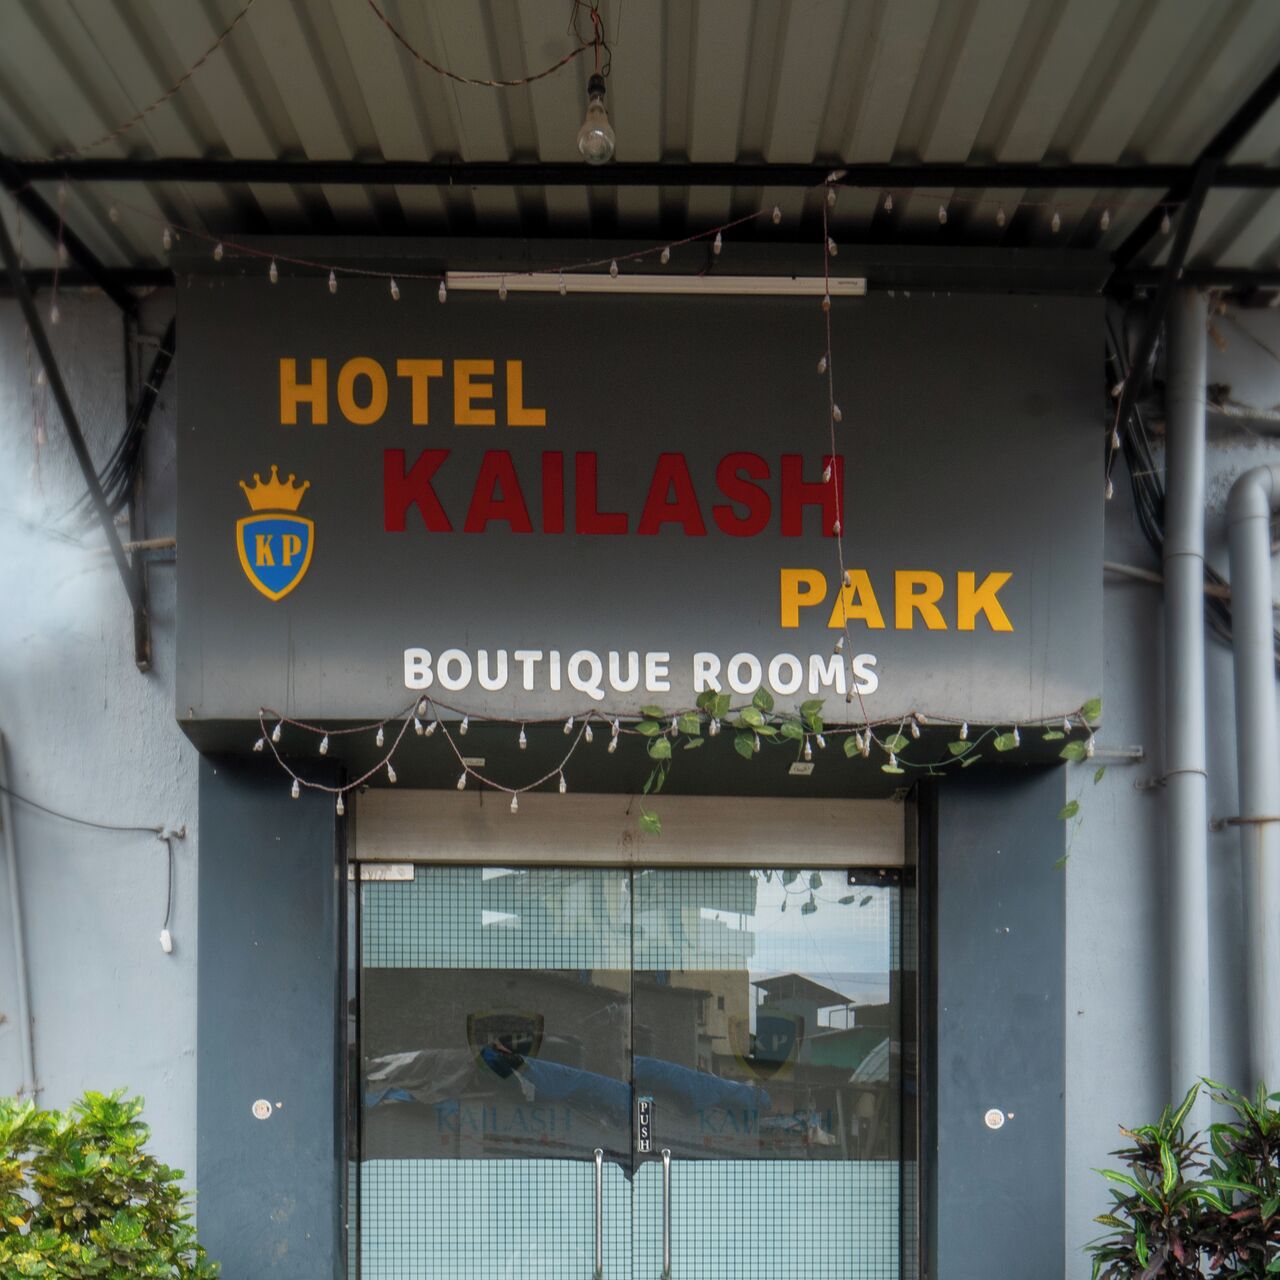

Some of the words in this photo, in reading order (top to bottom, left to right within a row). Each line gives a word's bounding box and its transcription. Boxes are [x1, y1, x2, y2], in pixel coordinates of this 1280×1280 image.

[280, 358, 546, 426] HOTEL
[383, 448, 845, 538] KAILASH
[255, 534, 302, 566] KP
[779, 568, 1014, 632] PARK
[404, 647, 671, 701] BOUTIQUE
[693, 652, 879, 696] ROOMS
[639, 1101, 650, 1150] PUSH
